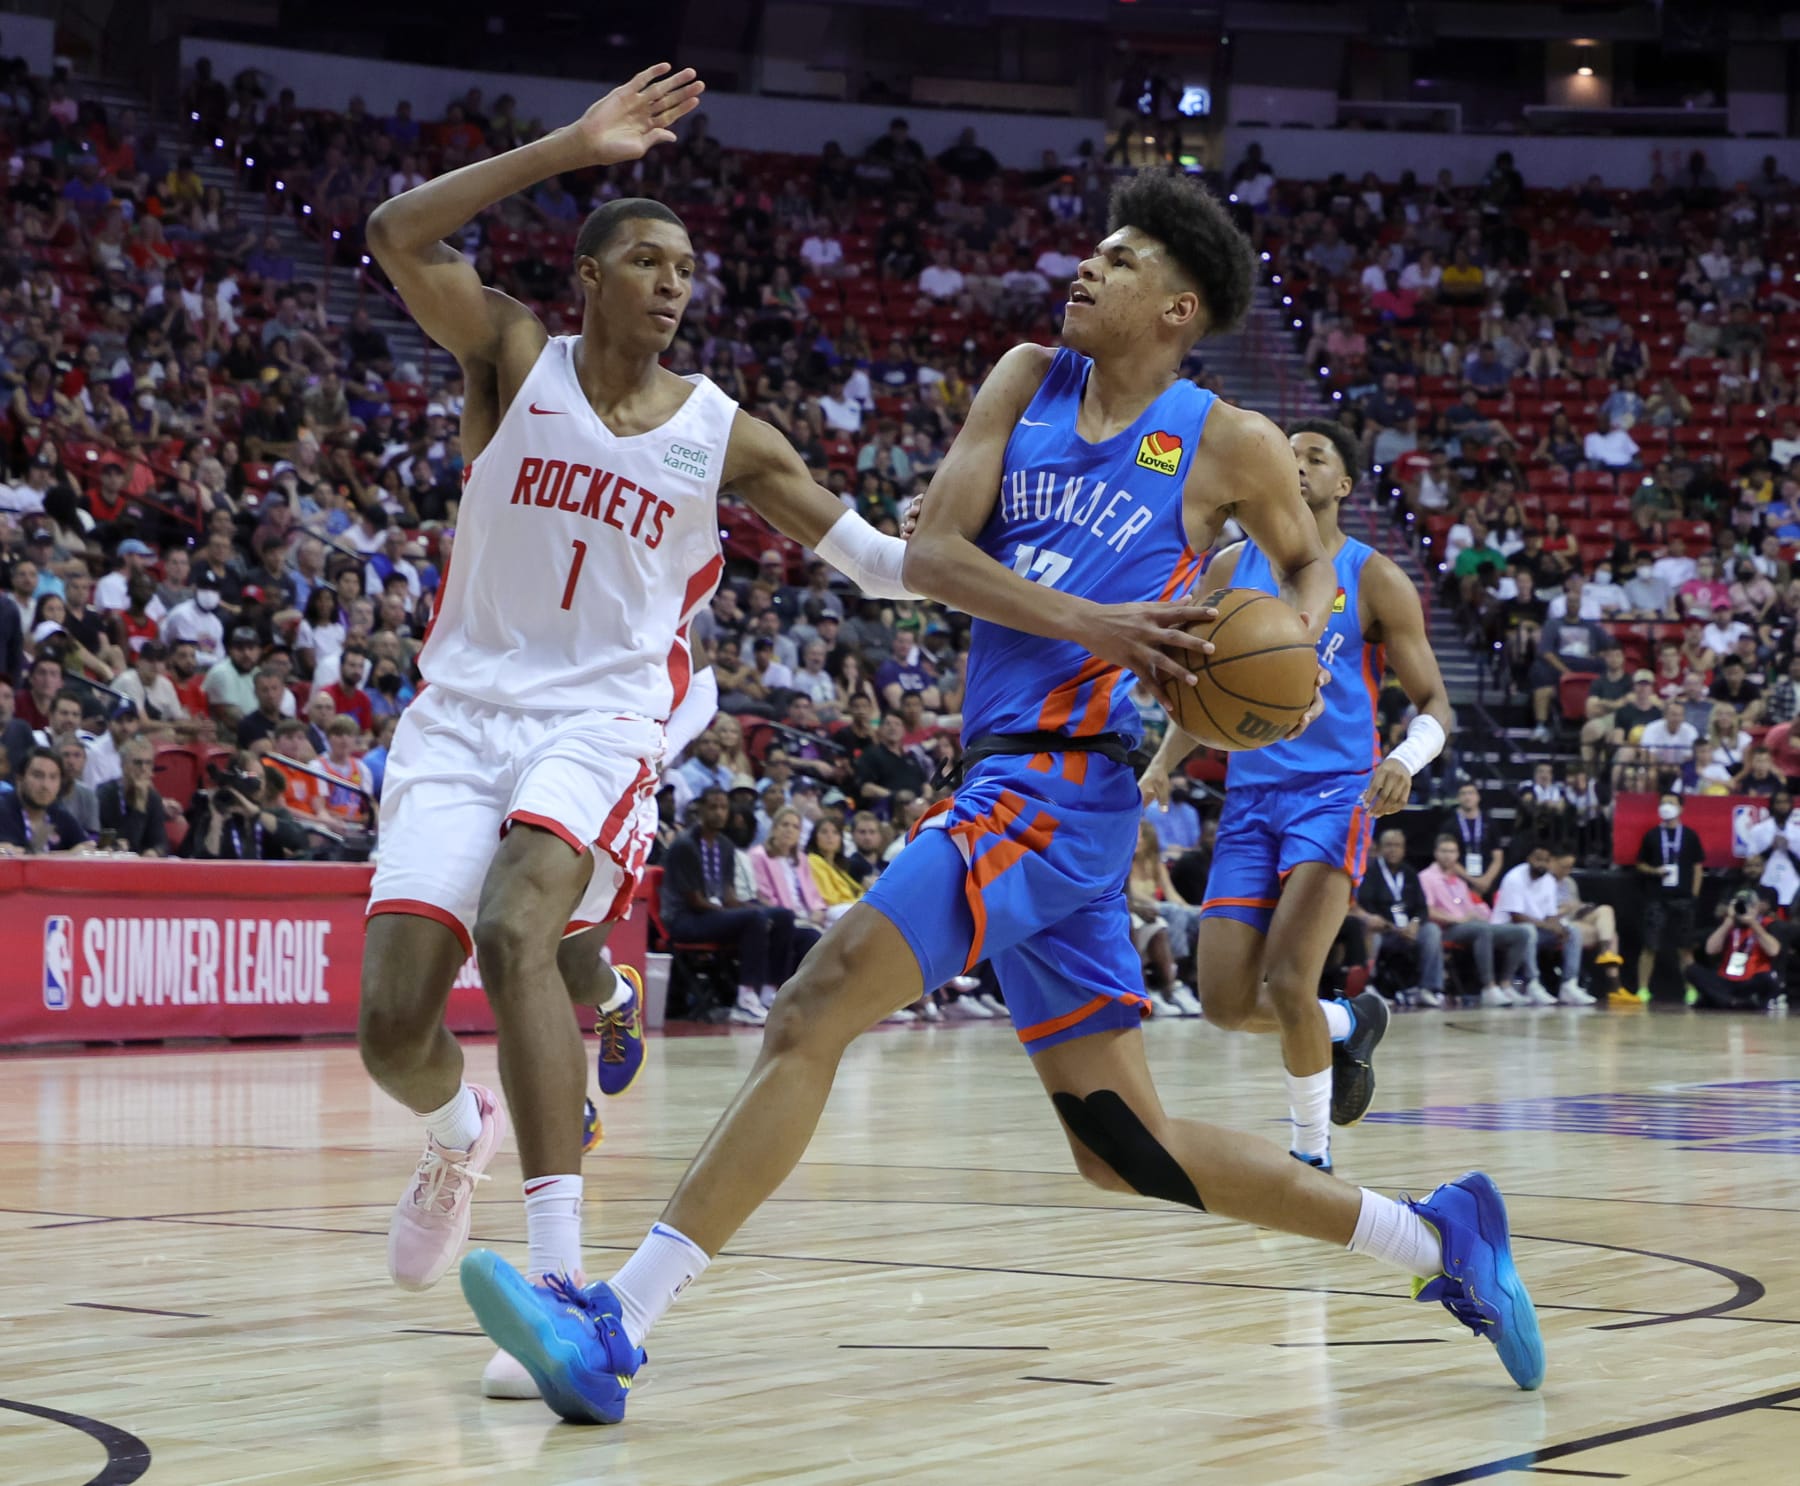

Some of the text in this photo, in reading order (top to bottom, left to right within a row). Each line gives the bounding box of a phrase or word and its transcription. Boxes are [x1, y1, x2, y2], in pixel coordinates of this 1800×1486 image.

[663, 452, 707, 479] karma
[670, 443, 709, 466] credit
[510, 457, 676, 550] ROCKETS
[560, 539, 588, 611] 1
[81, 917, 332, 1008] SUMMER LEAGUE
